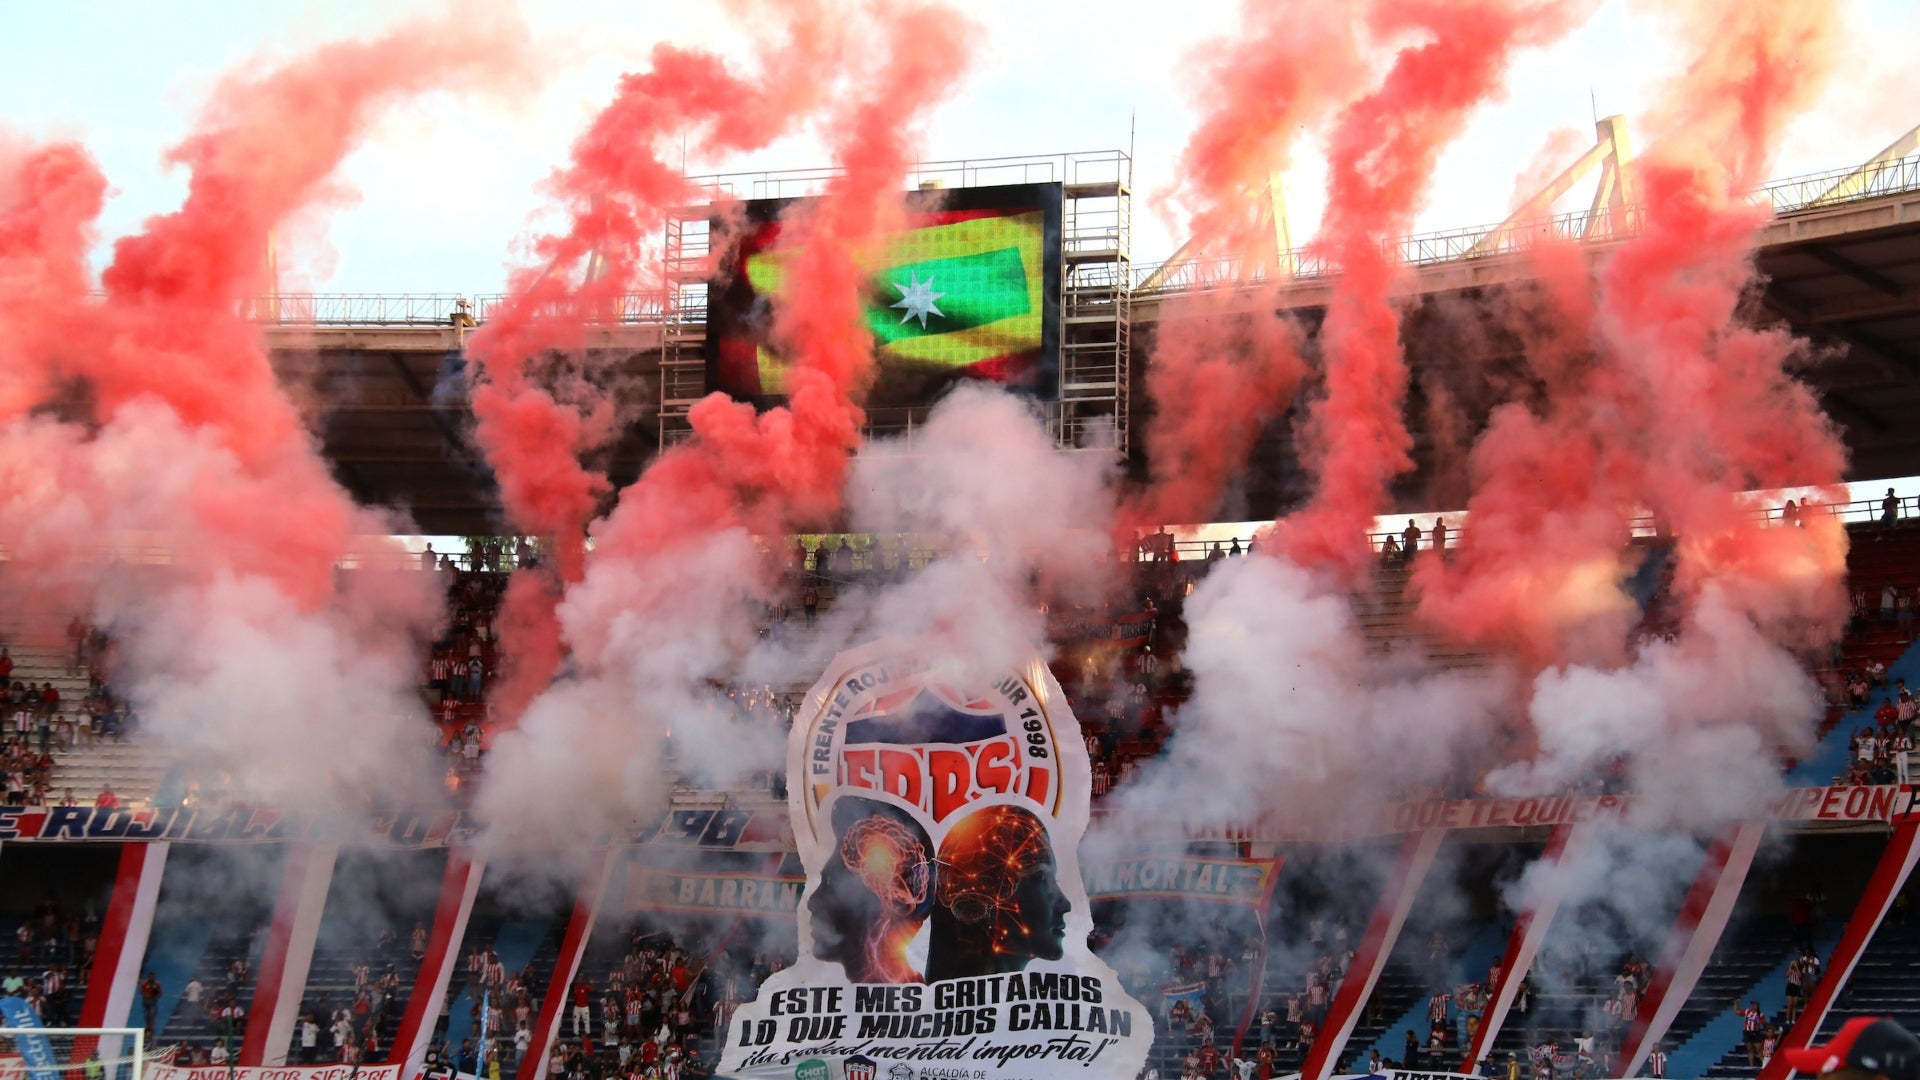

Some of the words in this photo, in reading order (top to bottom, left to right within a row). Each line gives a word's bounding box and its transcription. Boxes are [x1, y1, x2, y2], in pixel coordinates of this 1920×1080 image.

[813, 692, 850, 776] FRENTE
[990, 672, 1028, 706] SUR
[1020, 707, 1048, 759] 1998
[770, 986, 843, 1016] ESTE
[854, 986, 922, 1013] MES
[934, 972, 1102, 1010] GRITAMOS
[738, 1019, 777, 1047] LO
[786, 1015, 847, 1043] QUE
[856, 1007, 997, 1039] MUCHOS
[1008, 1003, 1131, 1037] CALLAN
[865, 1037, 977, 1061] mental
[973, 1070, 986, 1080] DE
